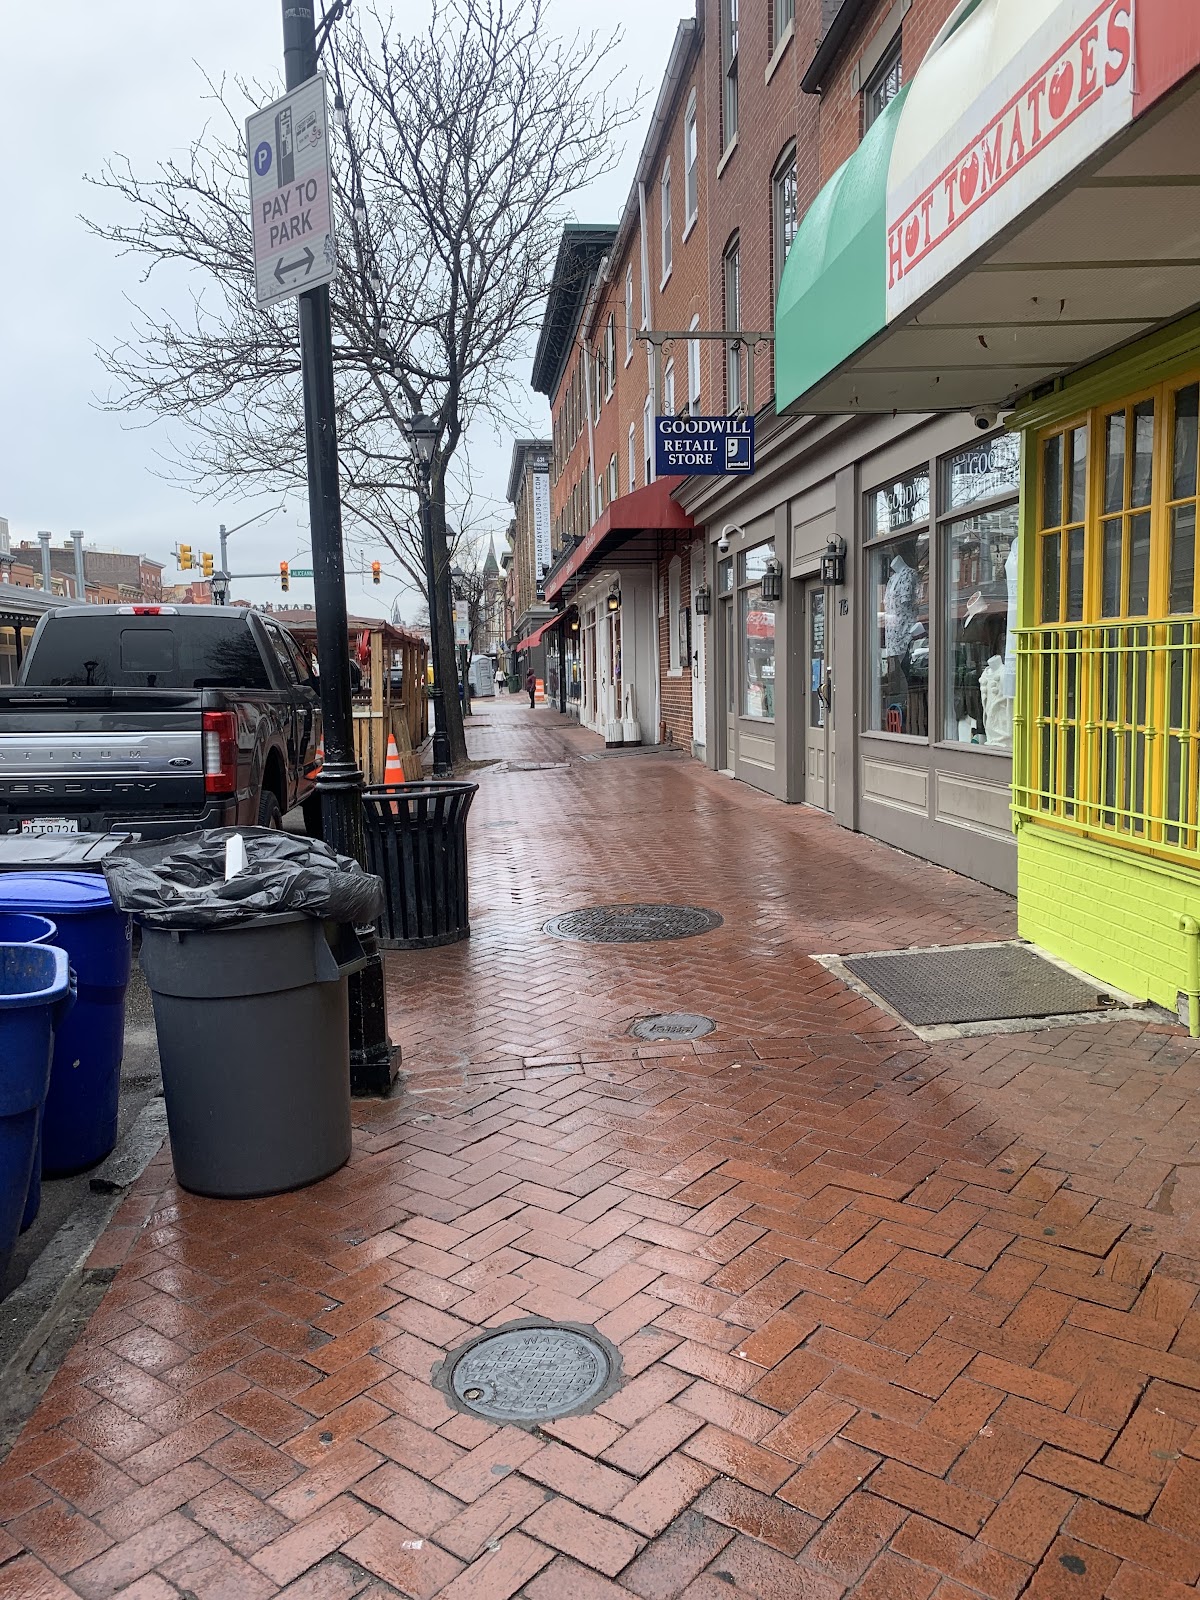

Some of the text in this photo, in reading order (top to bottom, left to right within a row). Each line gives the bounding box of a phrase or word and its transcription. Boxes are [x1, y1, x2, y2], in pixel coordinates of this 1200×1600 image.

[888, 0, 1131, 290] HOT TOMATOES
[262, 178, 318, 224] PAY TO
[270, 209, 313, 248] PARK
[659, 420, 751, 434] GOODWILL
[663, 439, 718, 451] RETAIL
[668, 453, 713, 465] STORE
[0, 751, 141, 760] ATINUM
[65, 783, 157, 792] DUTY
